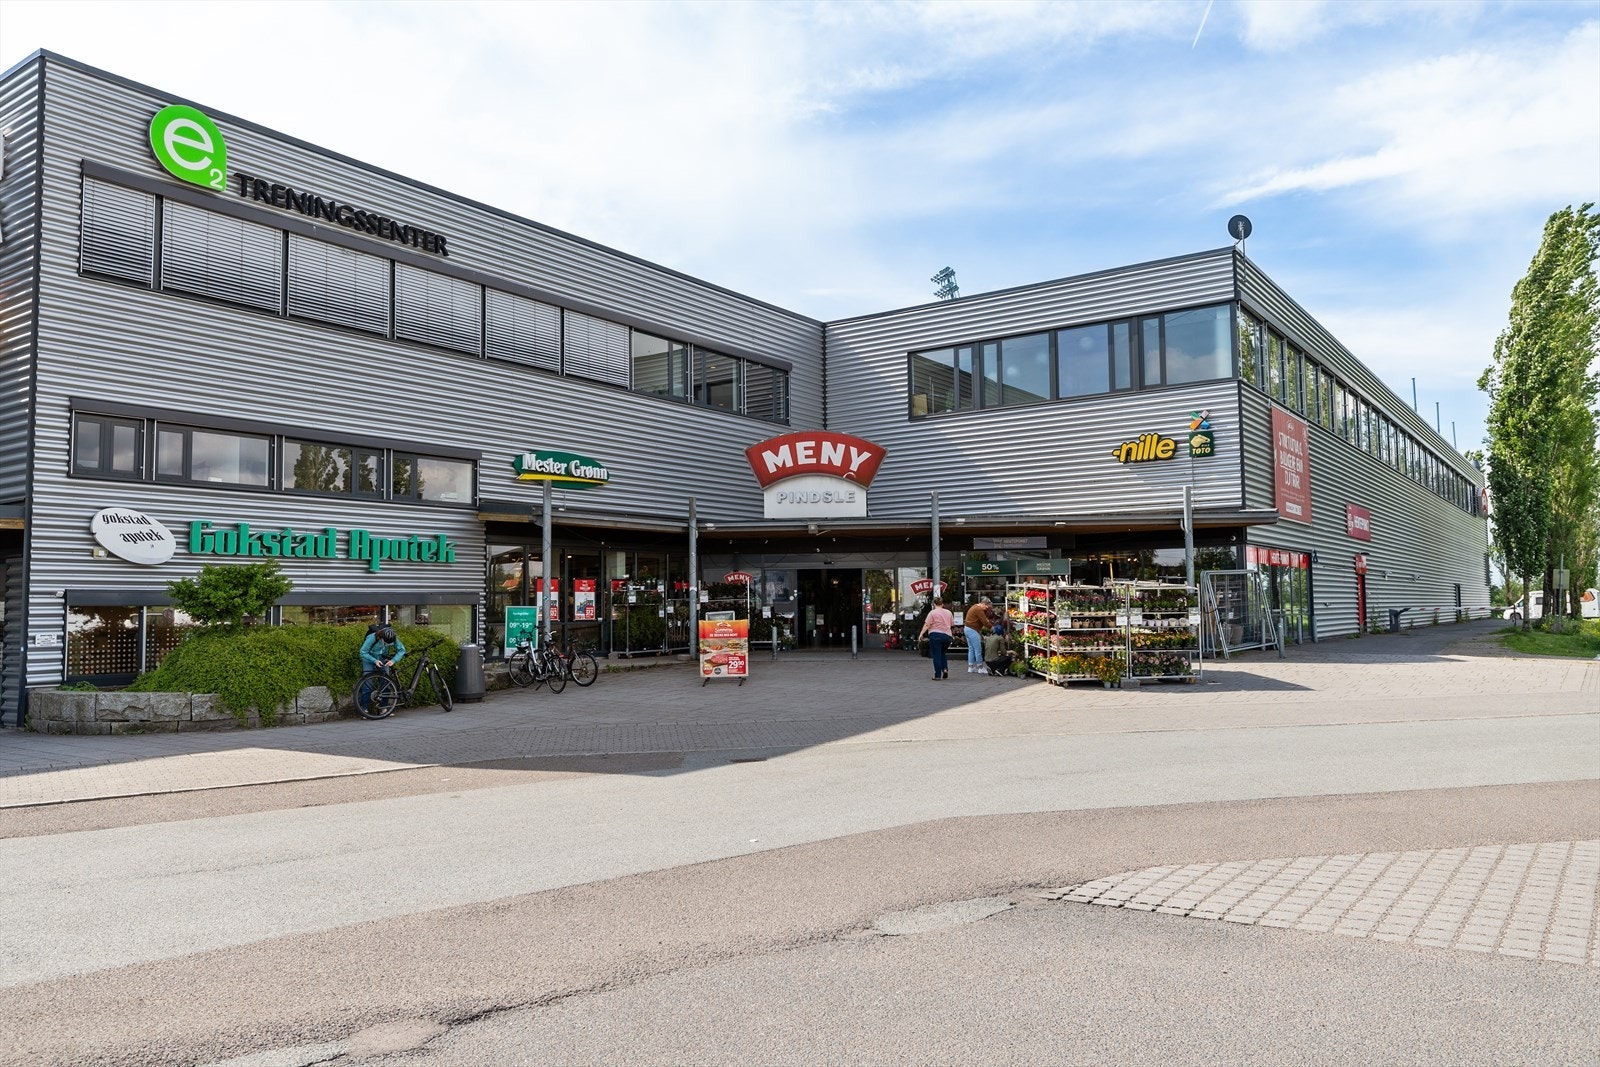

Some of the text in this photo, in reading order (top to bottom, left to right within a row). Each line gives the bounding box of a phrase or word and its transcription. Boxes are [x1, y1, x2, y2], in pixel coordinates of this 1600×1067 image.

[233, 172, 449, 256] TRENINGSSENTER
[761, 441, 872, 474] MENY
[1192, 447, 1211, 455] TOTO
[522, 453, 608, 480] Mester Grønn
[776, 491, 856, 504] PINDSLE
[102, 513, 153, 526] gokstad
[119, 529, 166, 545] apotek
[188, 520, 458, 573] Gokstad Apotek
